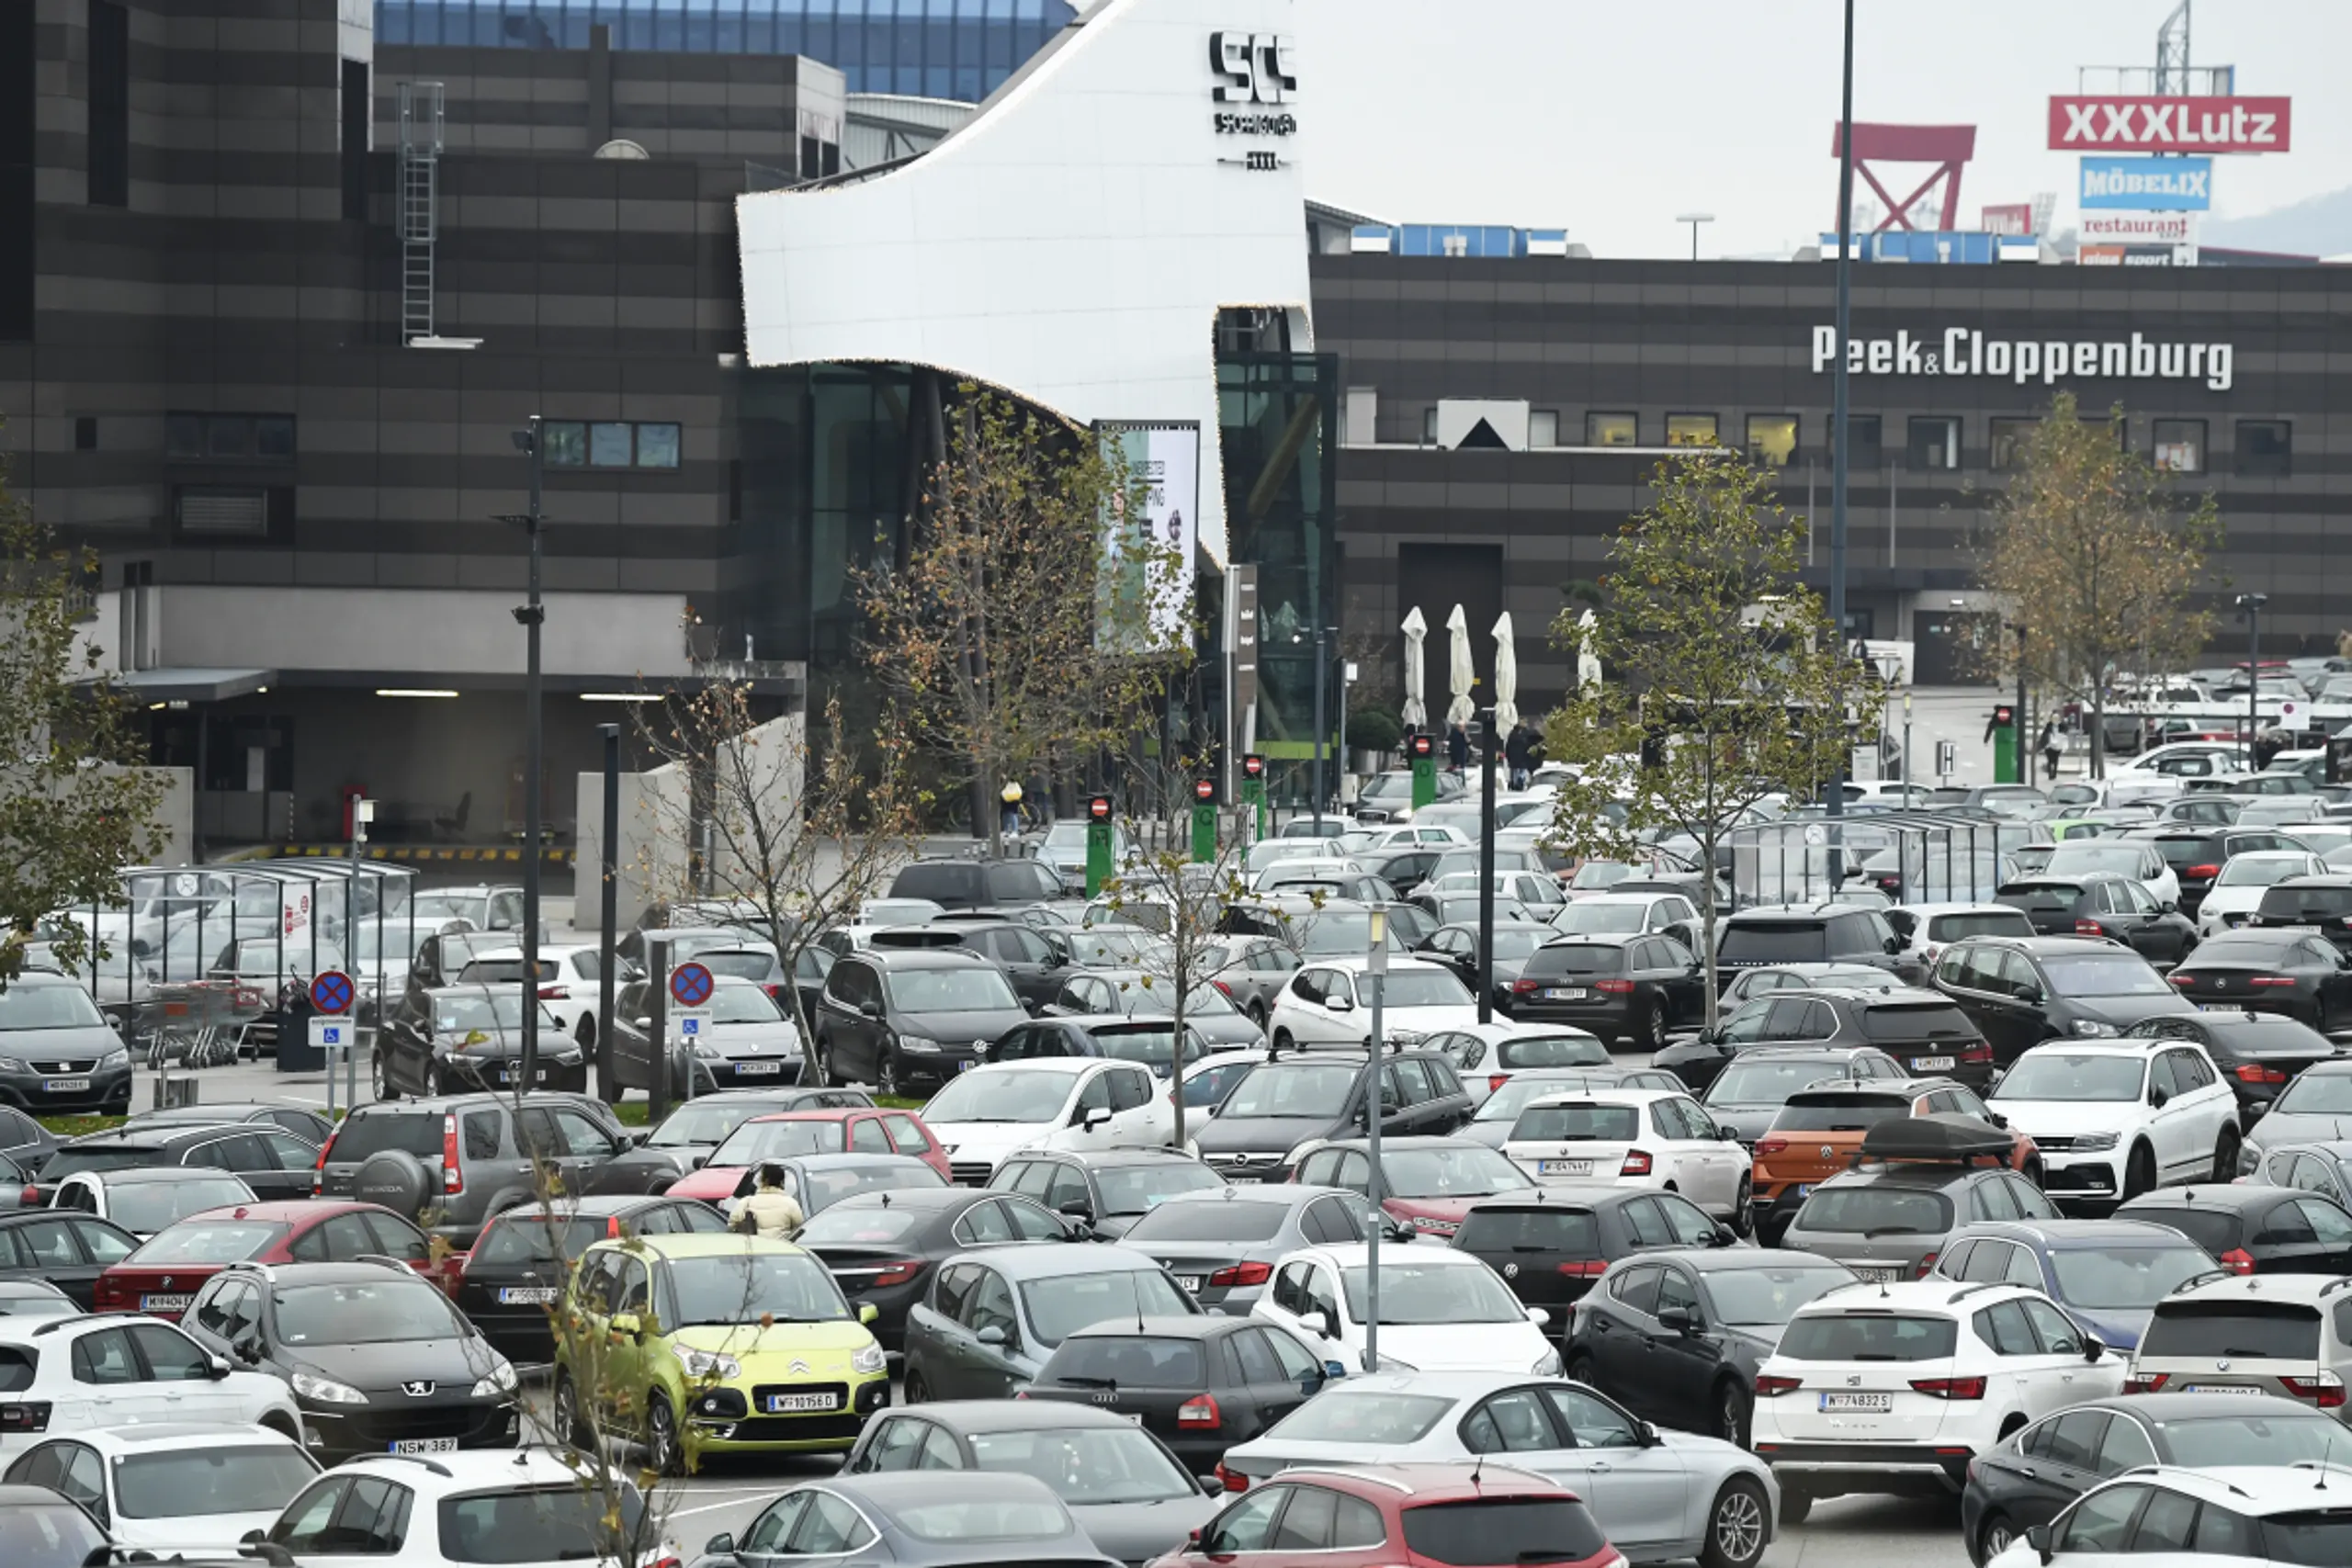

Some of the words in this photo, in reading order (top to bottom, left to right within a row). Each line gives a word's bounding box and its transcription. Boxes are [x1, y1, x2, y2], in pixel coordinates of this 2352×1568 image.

[2063, 104, 2277, 142] XXXLutz
[2083, 166, 2208, 198] MÖBELIX
[2084, 218, 2188, 239] restaurant
[2124, 254, 2170, 265] sport
